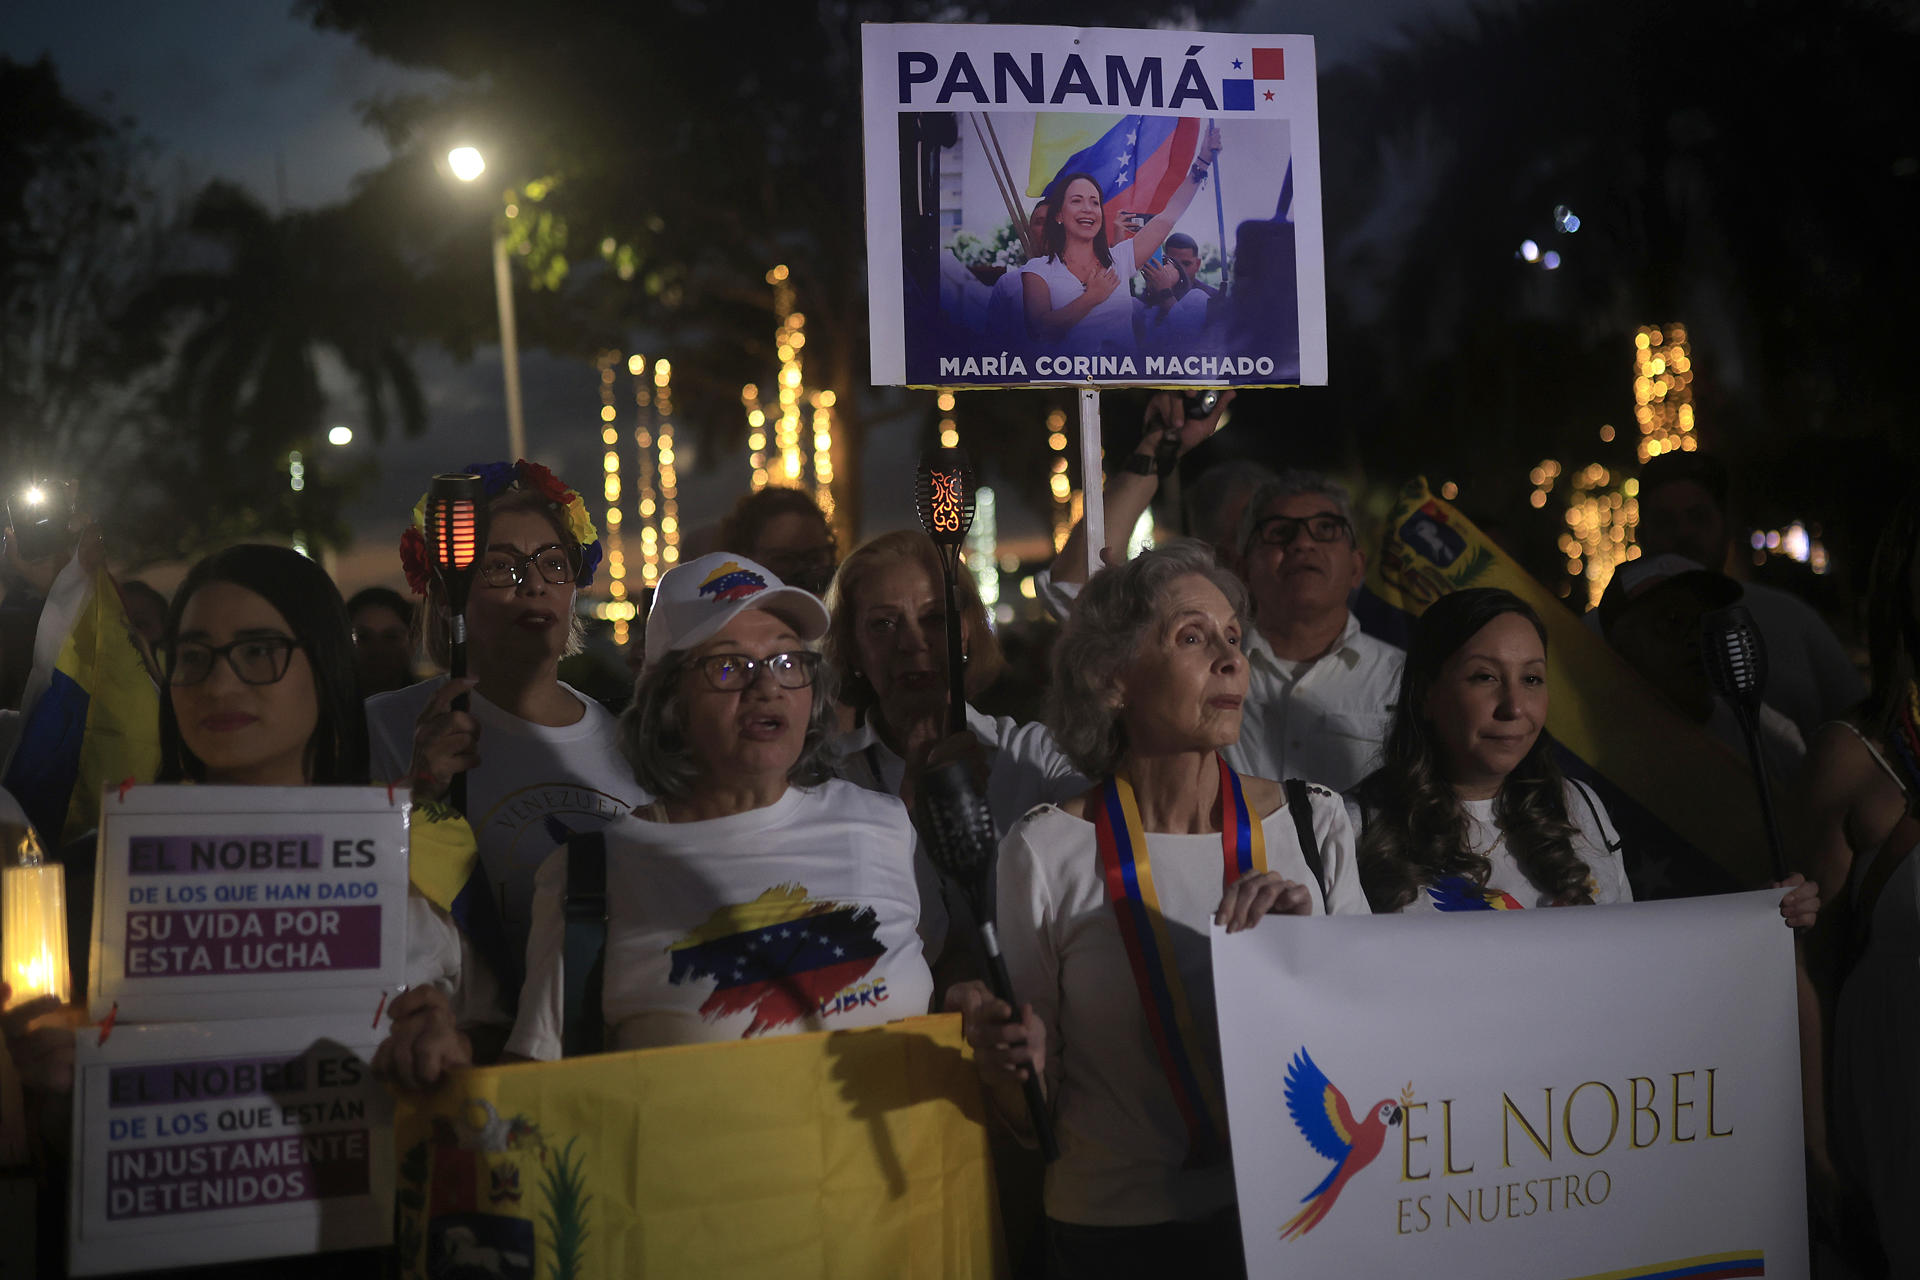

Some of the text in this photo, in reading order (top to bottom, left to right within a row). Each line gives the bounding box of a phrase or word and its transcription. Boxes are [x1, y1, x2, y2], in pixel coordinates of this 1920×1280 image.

[898, 45, 1219, 111] PANAMÁ
[940, 351, 1274, 376] MARÍA CORINA MACHADO
[130, 838, 376, 873] EL NOBEL ES
[129, 882, 378, 904] DE LOS QUE HAN DADO
[129, 911, 339, 942] SU VIDA POR
[129, 942, 332, 973] ESTA LUCHA
[819, 977, 889, 1018] LIBRE
[111, 1059, 362, 1103] EL NOBEL ES
[109, 1099, 365, 1141] DE LOS QUE ESTÁN
[1400, 1067, 1734, 1184] EL NOBEL
[111, 1133, 364, 1180] INJUSTAMENTE
[111, 1172, 305, 1214] DETENIDOS
[1397, 1169, 1612, 1235] ES NUESTRO
